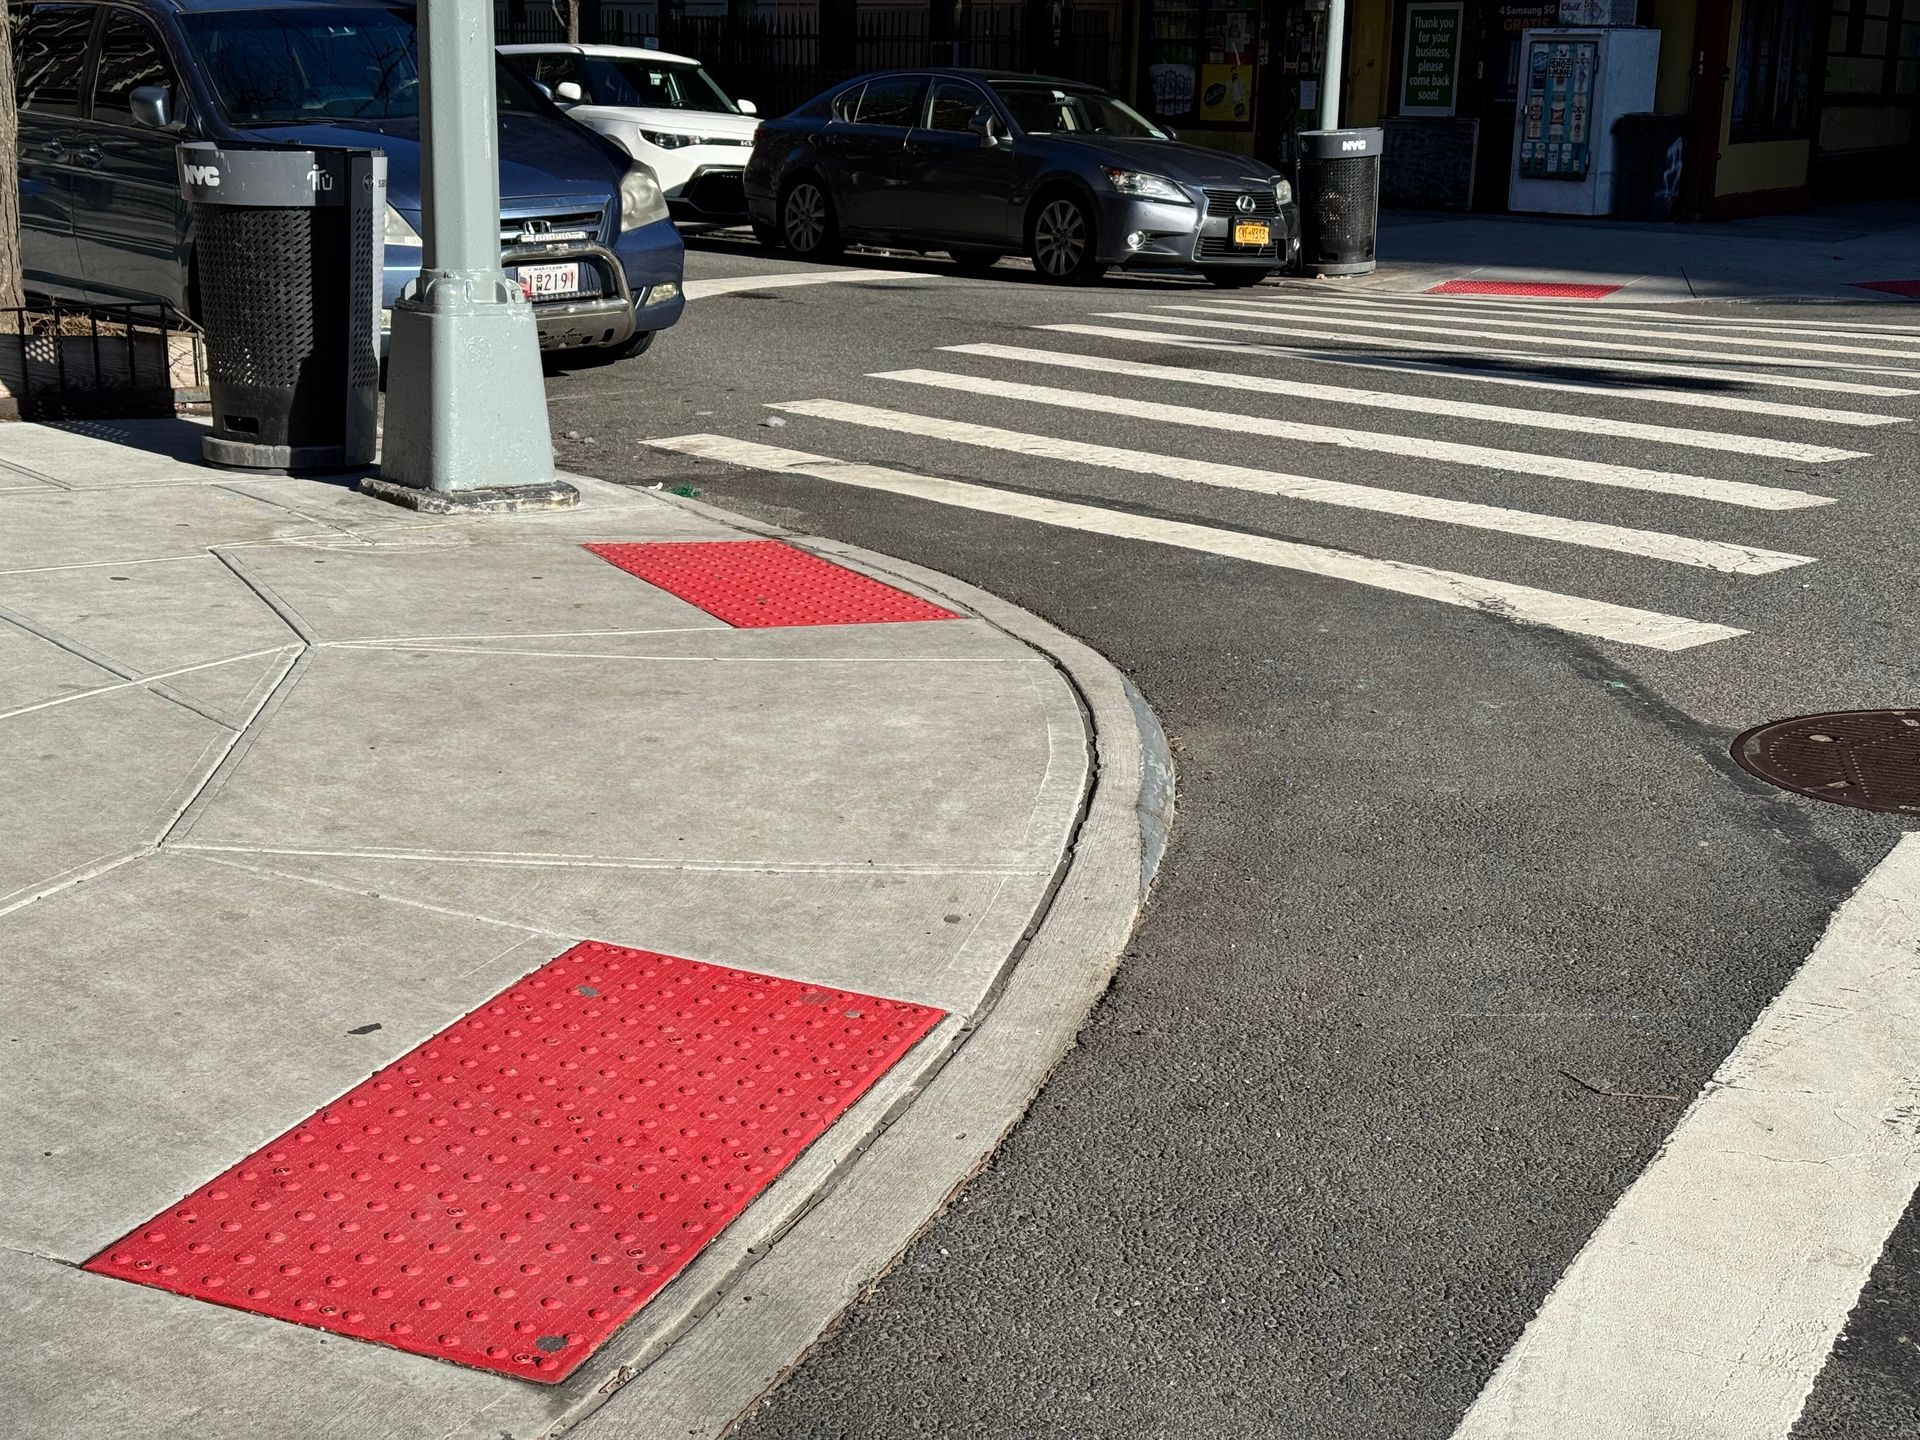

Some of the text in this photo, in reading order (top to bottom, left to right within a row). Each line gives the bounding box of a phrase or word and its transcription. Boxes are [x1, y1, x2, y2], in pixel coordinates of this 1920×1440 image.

[1506, 4, 1543, 17] Samsung
[1543, 4, 1556, 14] 5G
[1414, 16, 1454, 31] Thank you
[1418, 31, 1450, 45] for your
[1415, 45, 1450, 58] business,
[1417, 60, 1444, 73] please
[1409, 74, 1450, 86] come back
[1417, 89, 1440, 100] soon!
[1342, 139, 1367, 151] NYC
[183, 163, 221, 187] NYC
